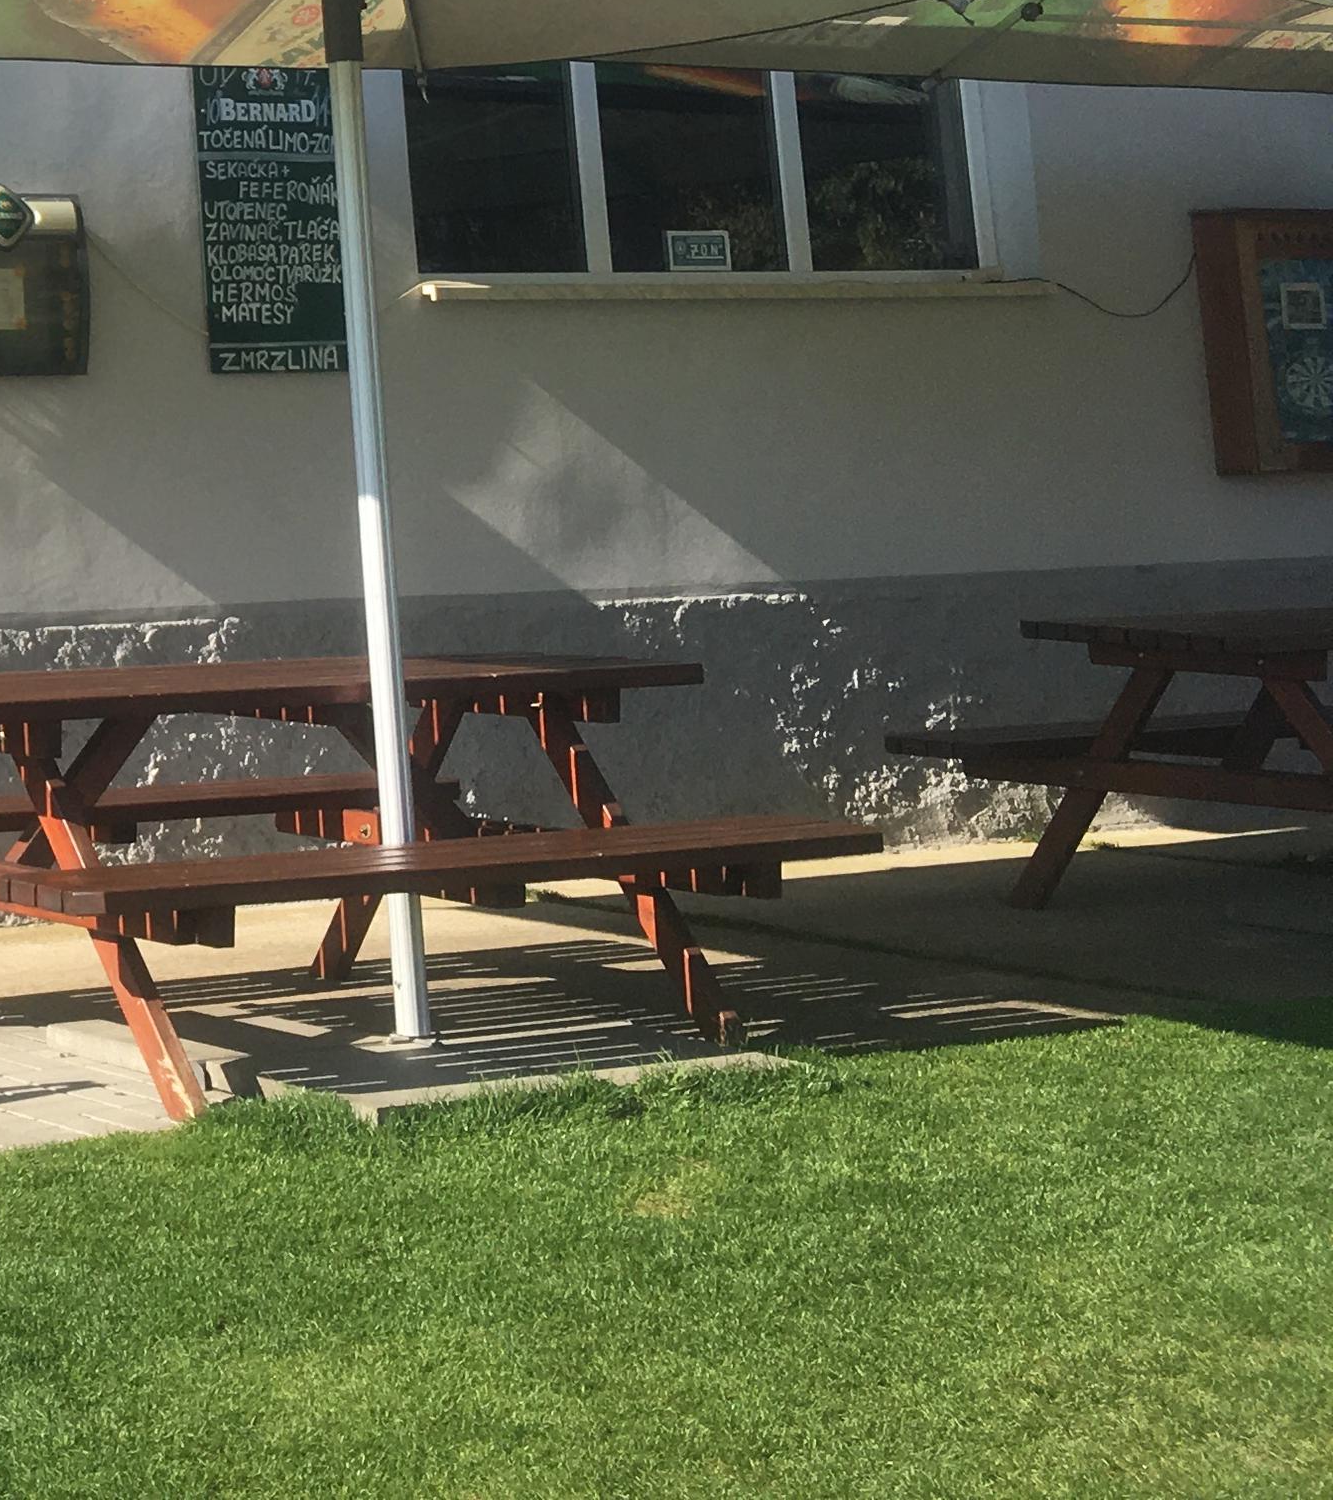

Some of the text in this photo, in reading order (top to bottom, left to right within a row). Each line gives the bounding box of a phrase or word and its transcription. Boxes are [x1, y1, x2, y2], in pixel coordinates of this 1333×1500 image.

[220, 98, 316, 122] BERNARD
[269, 129, 334, 154] LIMO-ZO
[204, 200, 288, 220] UTOPENEC
[219, 347, 338, 371] ZMRZLINA
